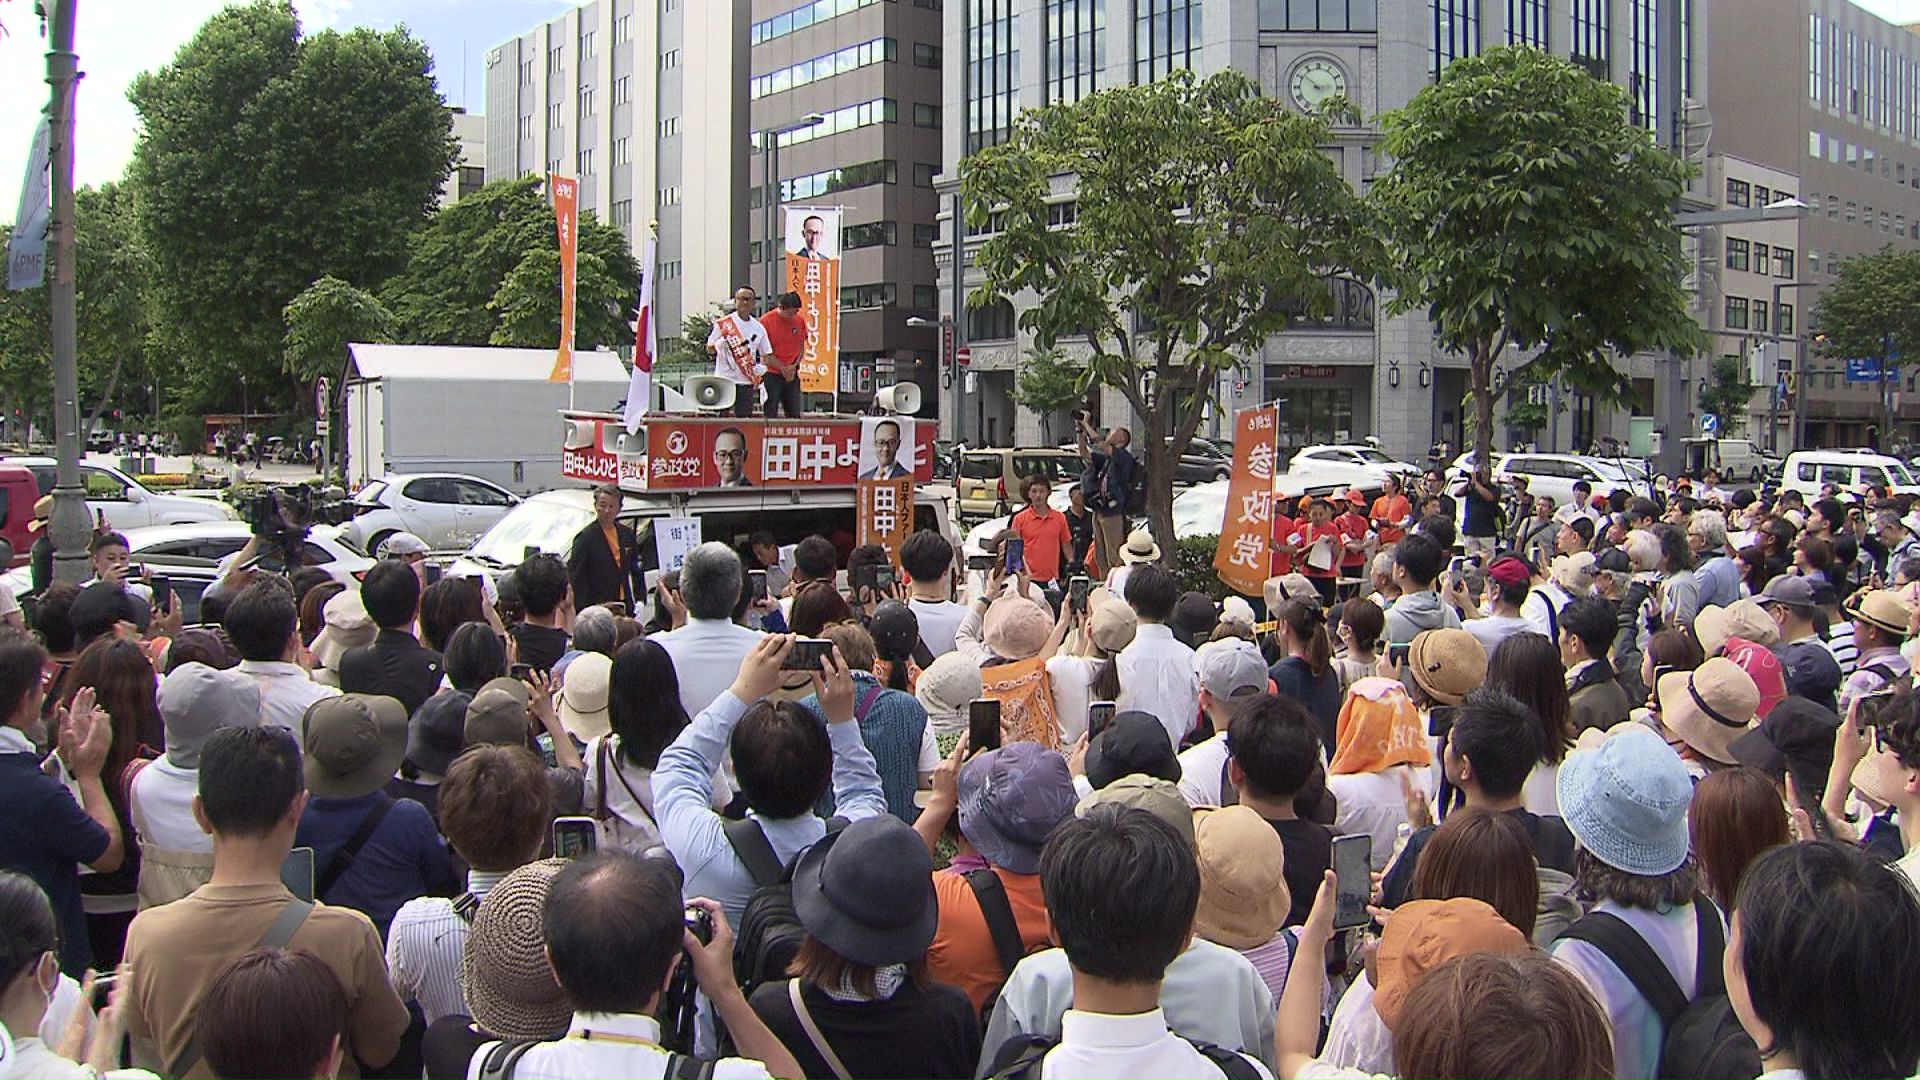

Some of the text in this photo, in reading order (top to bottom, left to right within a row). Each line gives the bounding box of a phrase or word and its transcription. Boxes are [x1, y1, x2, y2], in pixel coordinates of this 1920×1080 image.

[563, 451, 617, 479] 田中よしひと
[652, 457, 700, 479] 参政党
